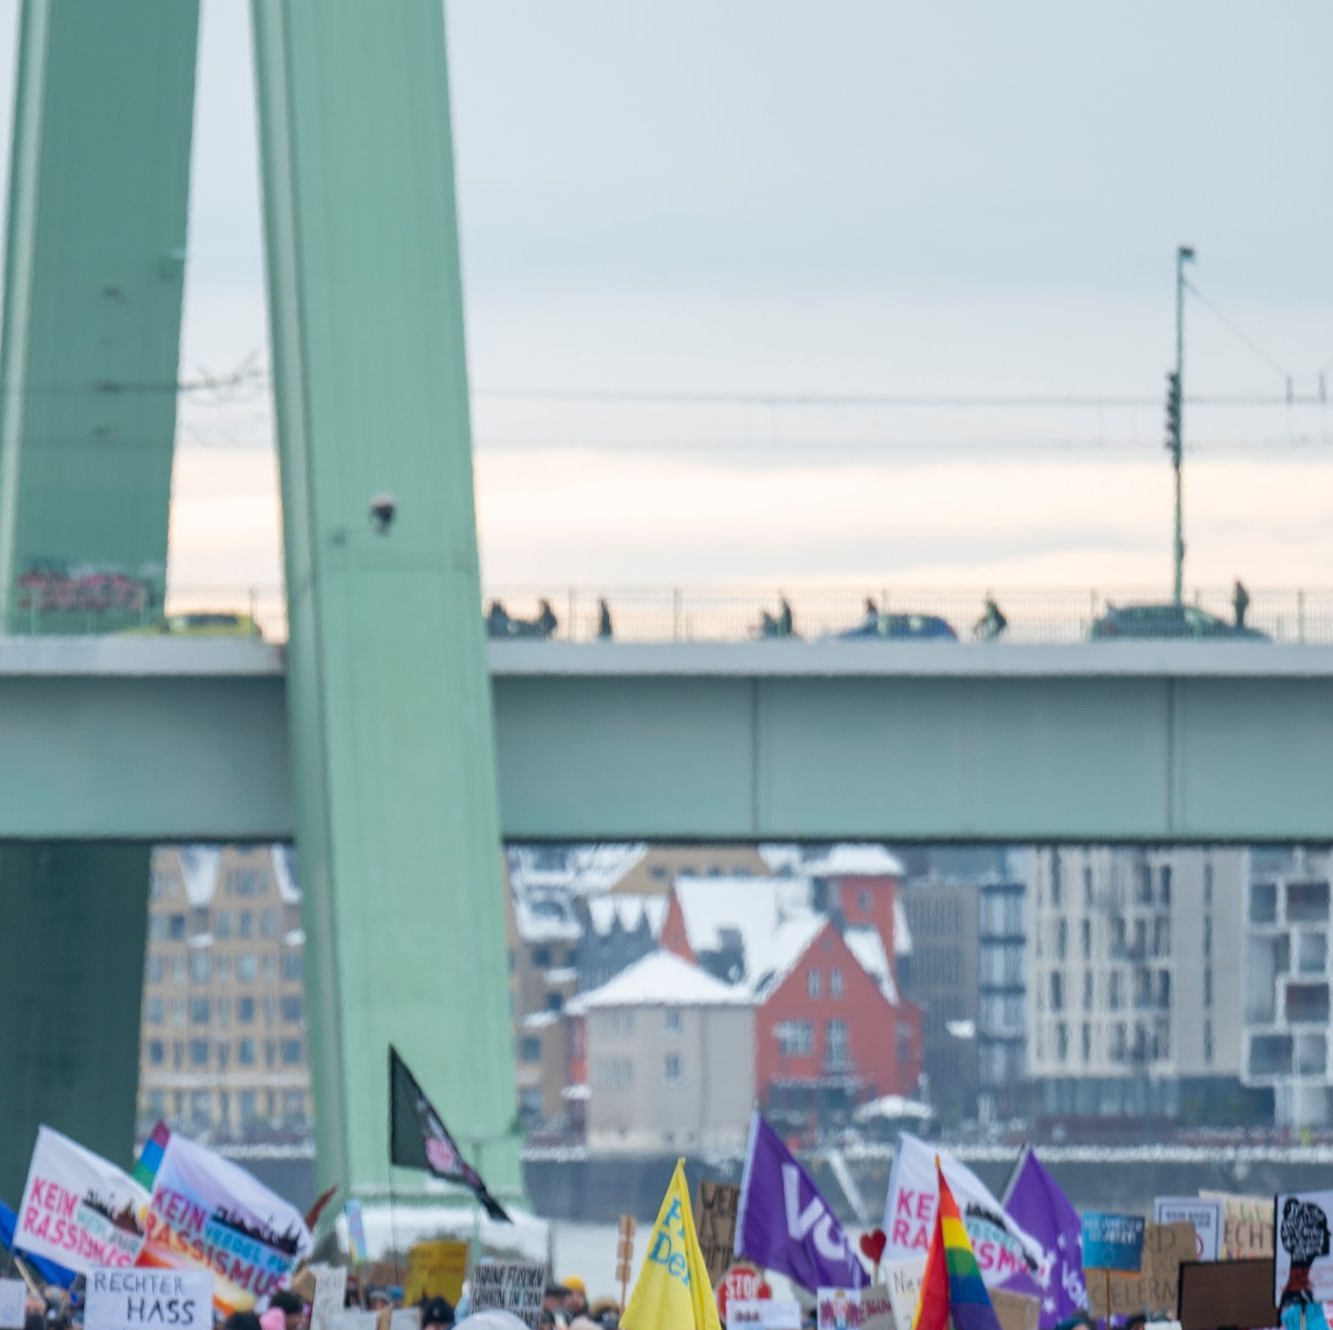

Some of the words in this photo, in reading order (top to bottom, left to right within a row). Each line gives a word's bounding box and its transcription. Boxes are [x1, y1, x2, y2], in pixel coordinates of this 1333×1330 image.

[29, 1177, 79, 1218] KEIN
[152, 1187, 206, 1233] KEIN
[94, 1271, 182, 1294] RECHTER
[127, 1298, 196, 1326] HASS
